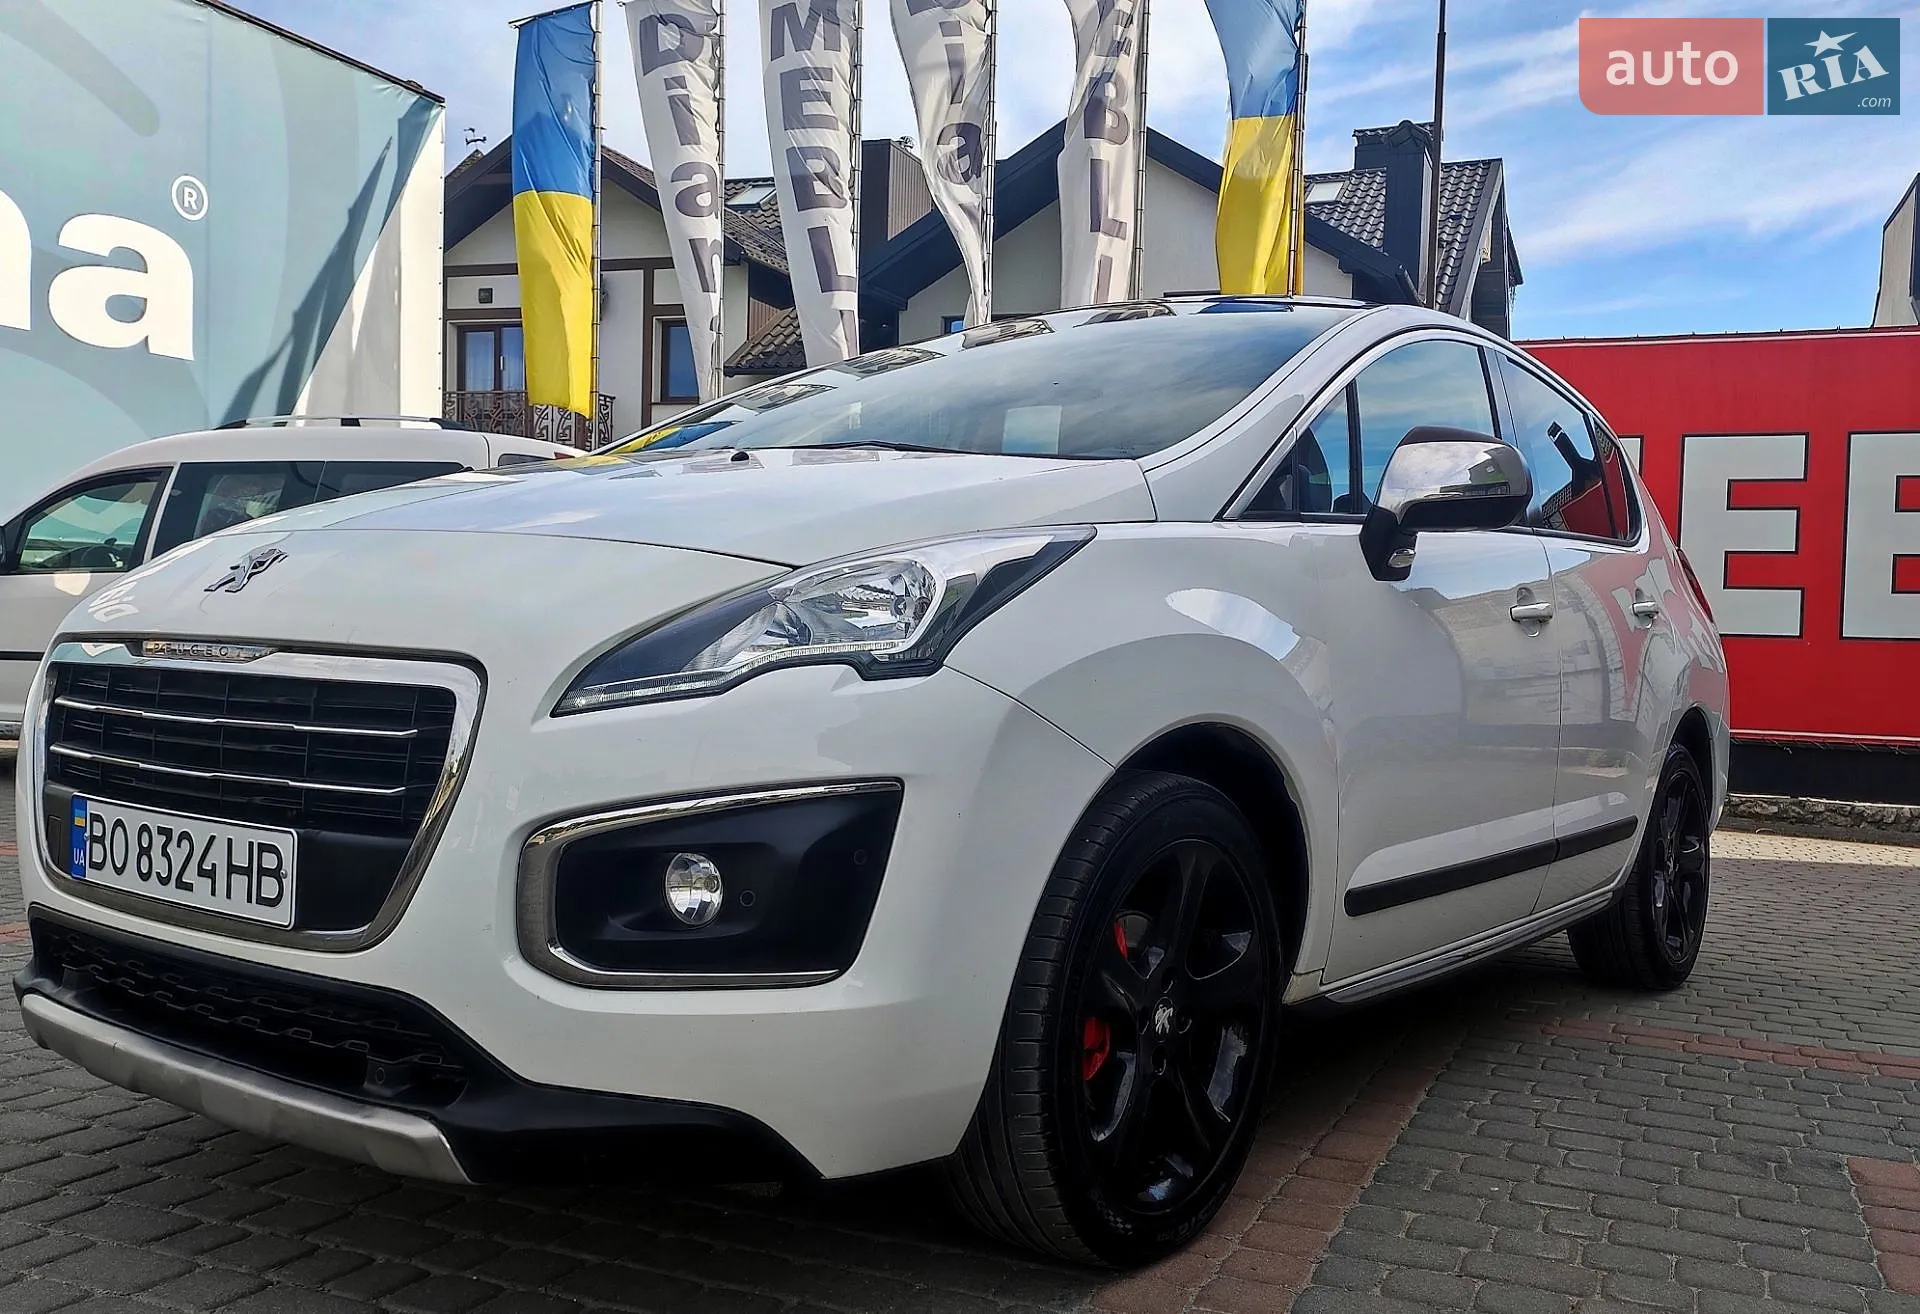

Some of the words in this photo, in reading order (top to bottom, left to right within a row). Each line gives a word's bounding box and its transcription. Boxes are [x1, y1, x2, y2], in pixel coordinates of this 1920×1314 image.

[905, 0, 983, 185] ia
[1083, 0, 1134, 305] EBLI
[73, 849, 85, 866] UA
[89, 812, 129, 876] BO
[136, 823, 217, 897] 8324
[226, 836, 284, 908] HB
